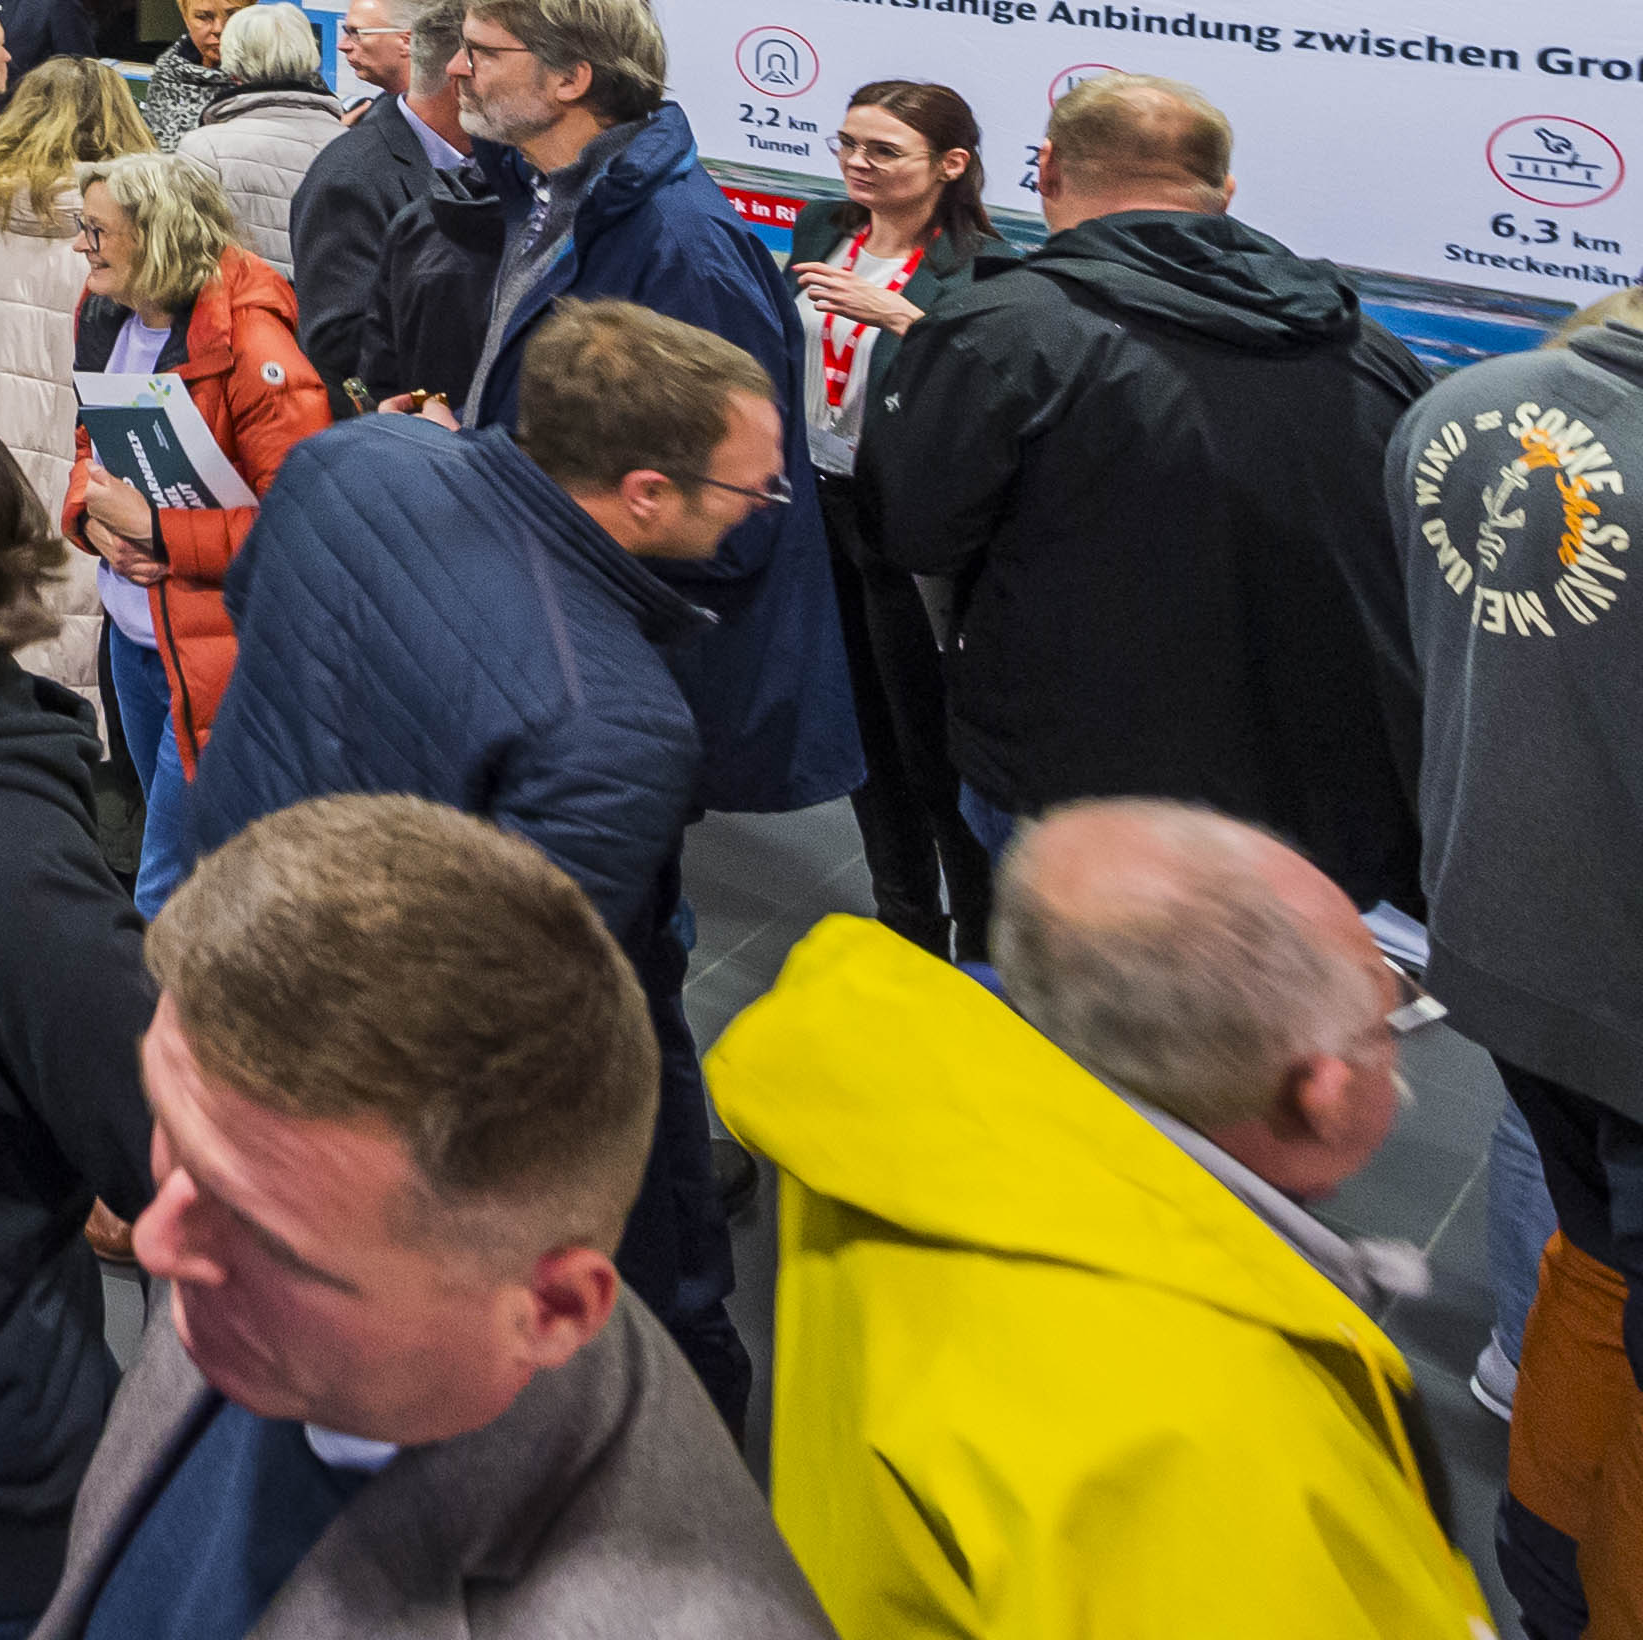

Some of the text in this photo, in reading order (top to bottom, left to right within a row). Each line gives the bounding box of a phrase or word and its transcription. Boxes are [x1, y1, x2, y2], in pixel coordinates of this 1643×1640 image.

[1047, 0, 1282, 52] Anbindung
[1293, 28, 1520, 71] zwischen
[738, 103, 818, 134] 2,2 km
[746, 134, 810, 157] Tunnel
[751, 200, 771, 217] in
[1490, 213, 1622, 255] 6,3 km
